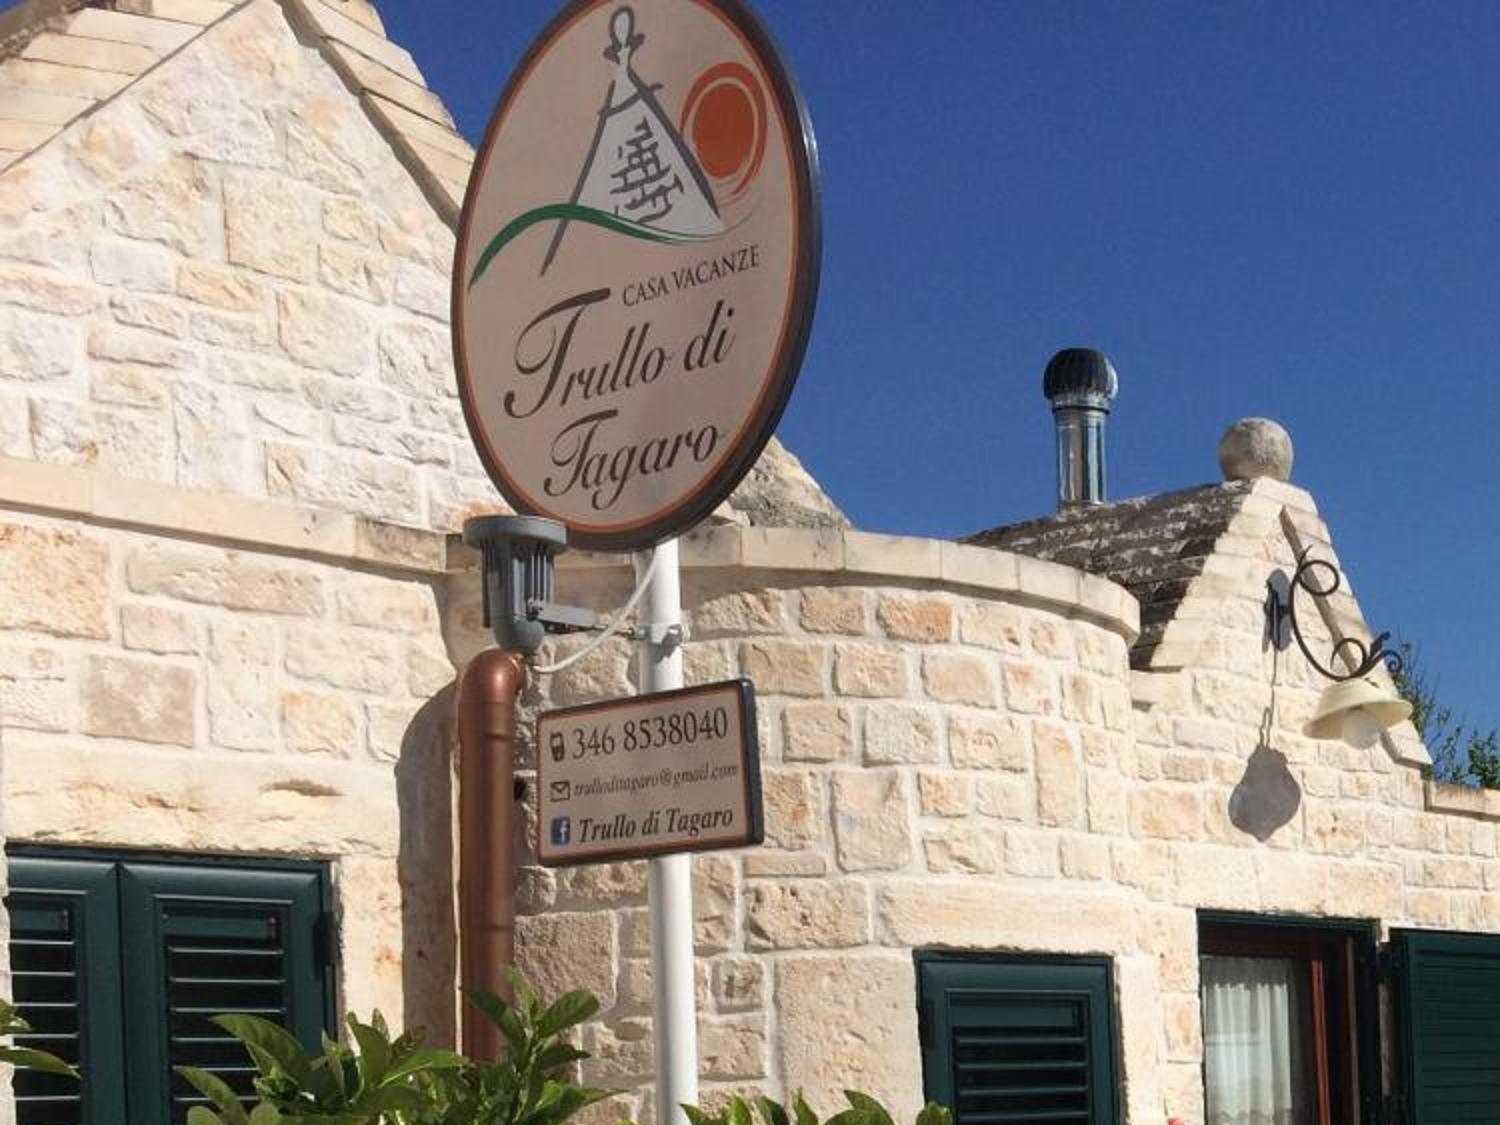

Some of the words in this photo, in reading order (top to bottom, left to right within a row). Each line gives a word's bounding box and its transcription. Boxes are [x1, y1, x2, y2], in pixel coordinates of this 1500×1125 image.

[622, 278, 671, 306] CASA
[674, 244, 761, 291] VACANZE
[503, 287, 664, 418] Trullo
[683, 299, 736, 372] di
[543, 409, 718, 510] Tagaro
[572, 728, 616, 760] 346
[623, 707, 728, 752] 8538040
[578, 814, 637, 843] Trullo
[641, 809, 661, 834] di
[666, 807, 734, 836] Tagaro
